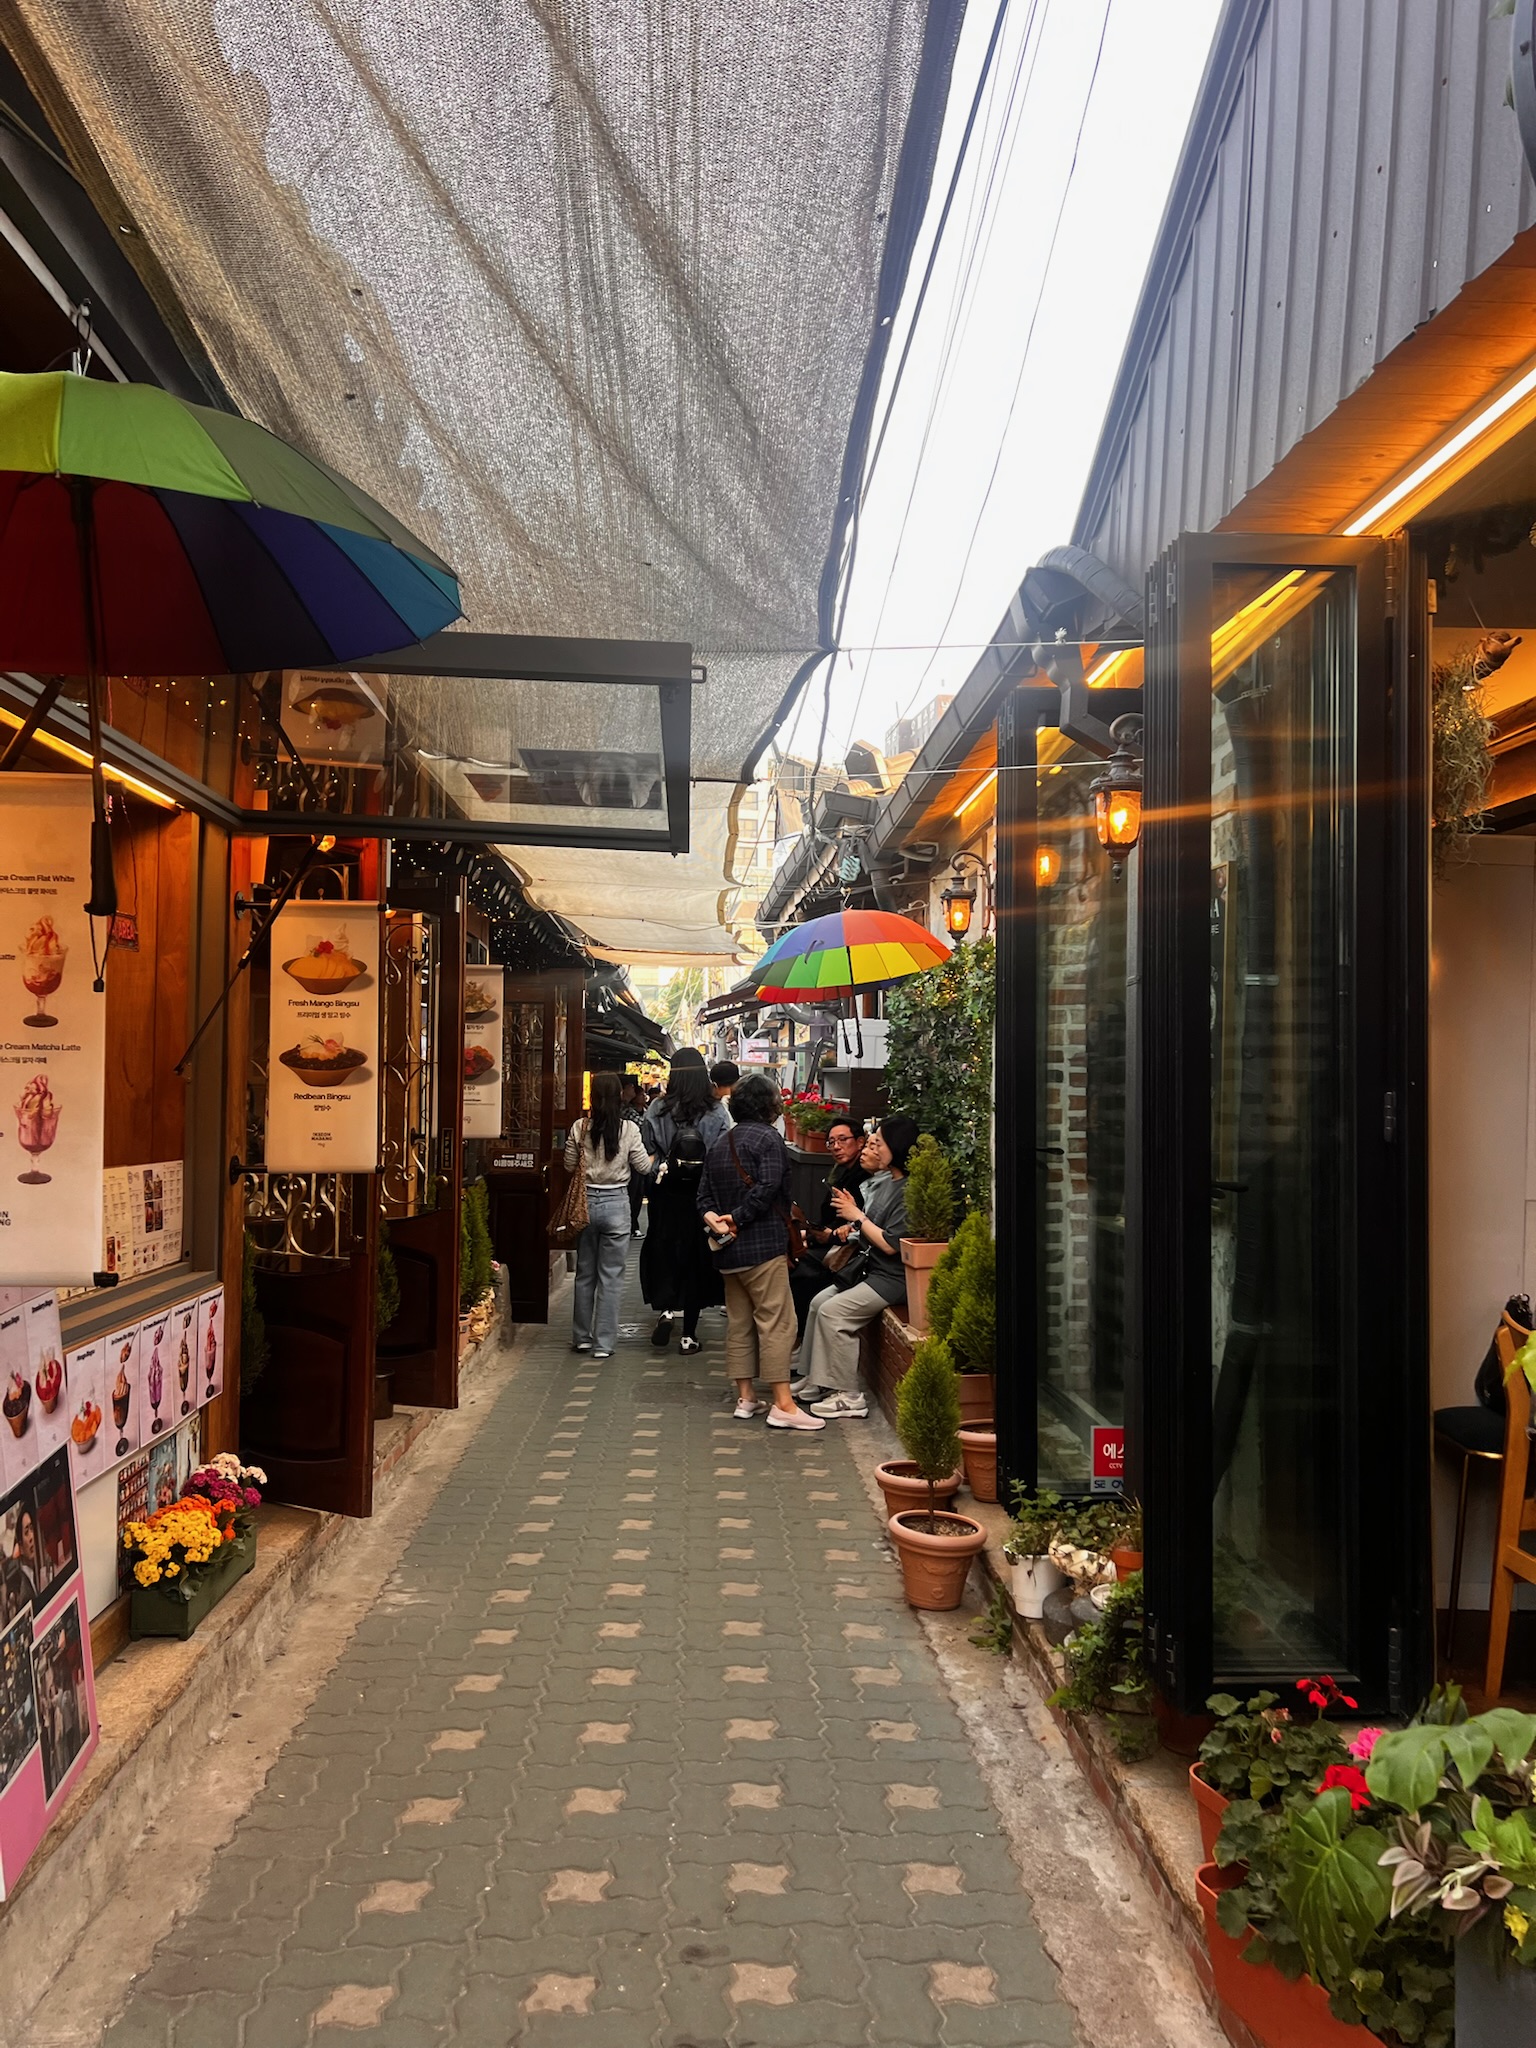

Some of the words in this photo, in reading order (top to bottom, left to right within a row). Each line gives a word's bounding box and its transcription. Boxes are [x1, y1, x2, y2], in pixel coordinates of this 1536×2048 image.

[309, 1000, 334, 1008] Mango
[335, 1000, 360, 1008] Bingsu
[31, 1043, 60, 1051] Matcha
[326, 1093, 351, 1102] Bingsu
